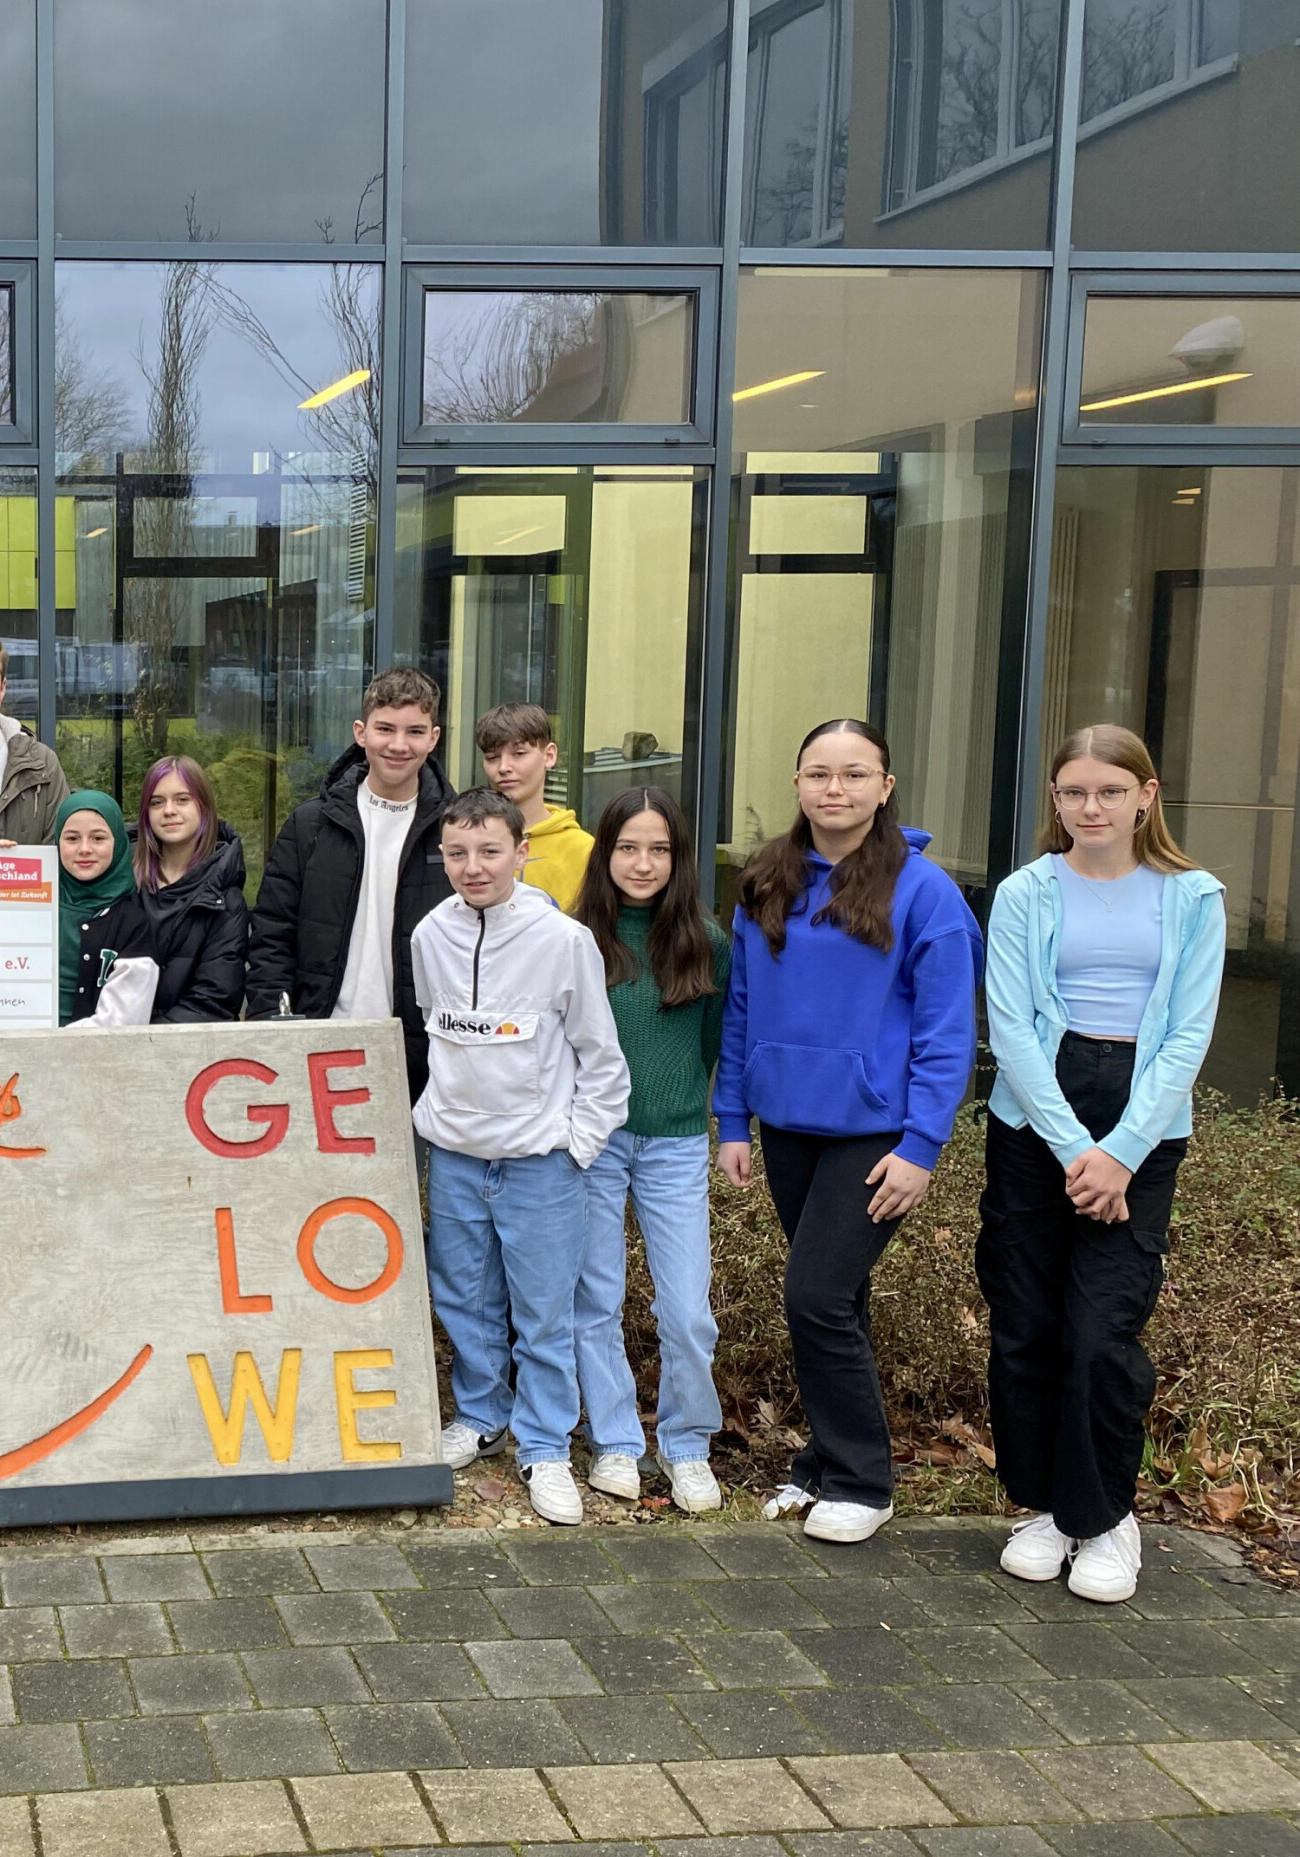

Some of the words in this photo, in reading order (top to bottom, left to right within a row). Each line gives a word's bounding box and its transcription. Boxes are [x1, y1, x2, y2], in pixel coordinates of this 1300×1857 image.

[380, 800, 409, 813] Angeles
[20, 891, 48, 899] Zukunft
[5, 957, 30, 970] e.V.
[185, 1049, 376, 1159] GE
[215, 1196, 403, 1314] LO
[186, 1348, 402, 1466] WE
